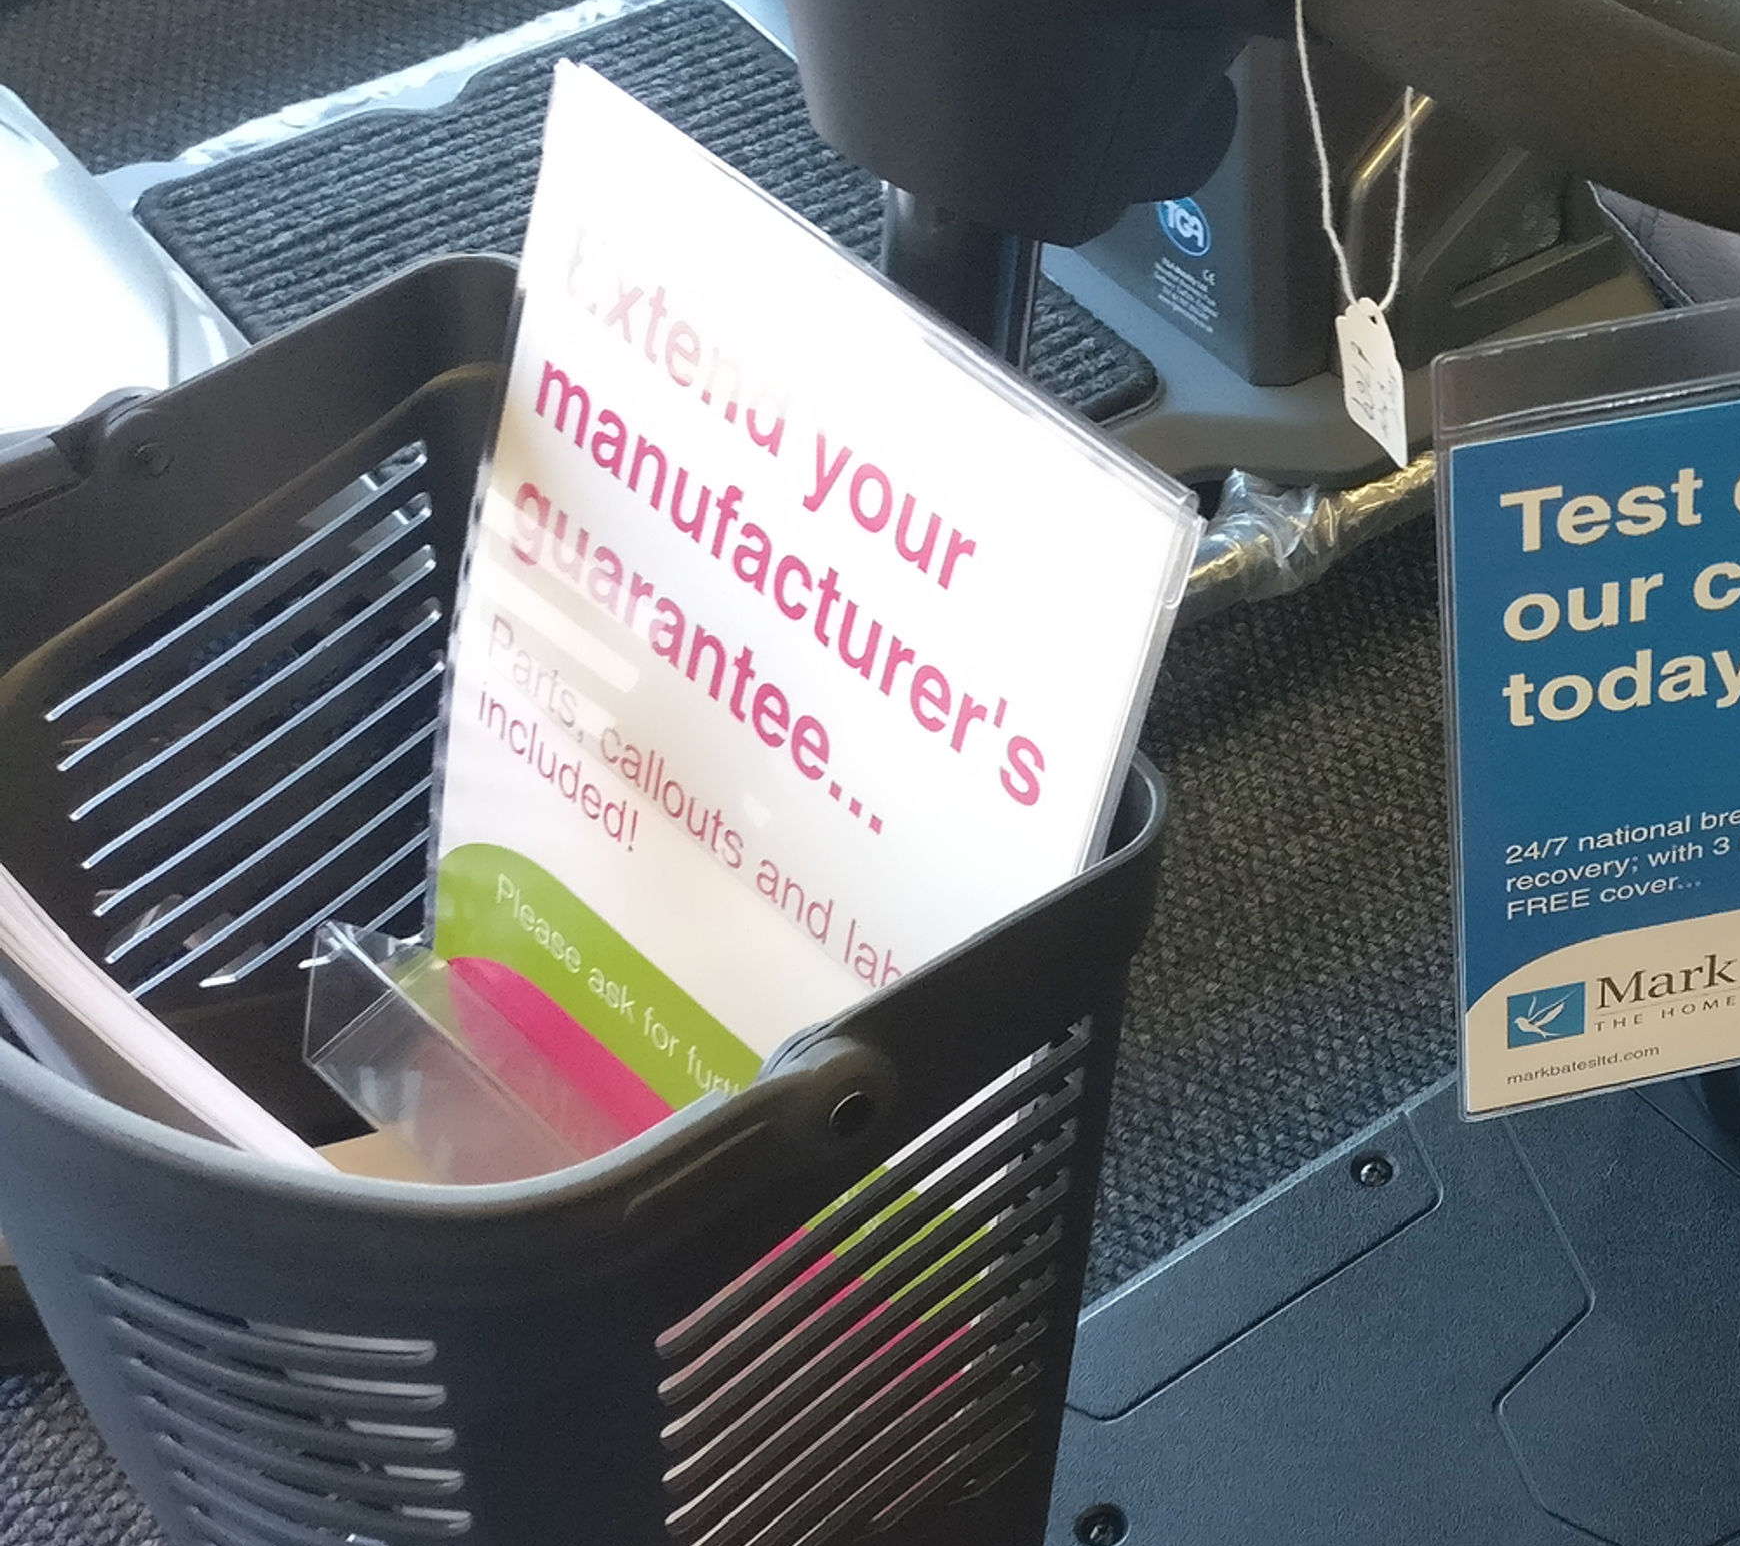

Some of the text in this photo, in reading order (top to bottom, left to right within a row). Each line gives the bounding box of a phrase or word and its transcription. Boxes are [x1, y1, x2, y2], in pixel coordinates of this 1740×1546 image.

[803, 429, 976, 591] your
[1500, 467, 1703, 552] Test
[534, 360, 1045, 806] manufacturer's
[1502, 572, 1664, 642] our
[509, 481, 883, 835] guarantee...
[479, 681, 639, 853] included!
[487, 613, 585, 744] Parts,
[600, 727, 742, 869] callouts
[756, 859, 834, 944] and
[1505, 836, 1569, 866] 24/7
[1578, 815, 1690, 852] national
[1505, 855, 1640, 893] recovery;
[1647, 841, 1703, 867] with
[1712, 836, 1730, 856] 3
[1505, 875, 1701, 921] FREE cover...
[495, 873, 581, 973] Please
[588, 967, 635, 1024] ask
[643, 1007, 680, 1058] for
[1596, 953, 1738, 1011] Mark
[1593, 1013, 1644, 1033] THE
[1661, 995, 1737, 1020] HOME
[1506, 1045, 1660, 1085] markbatesltd.com
